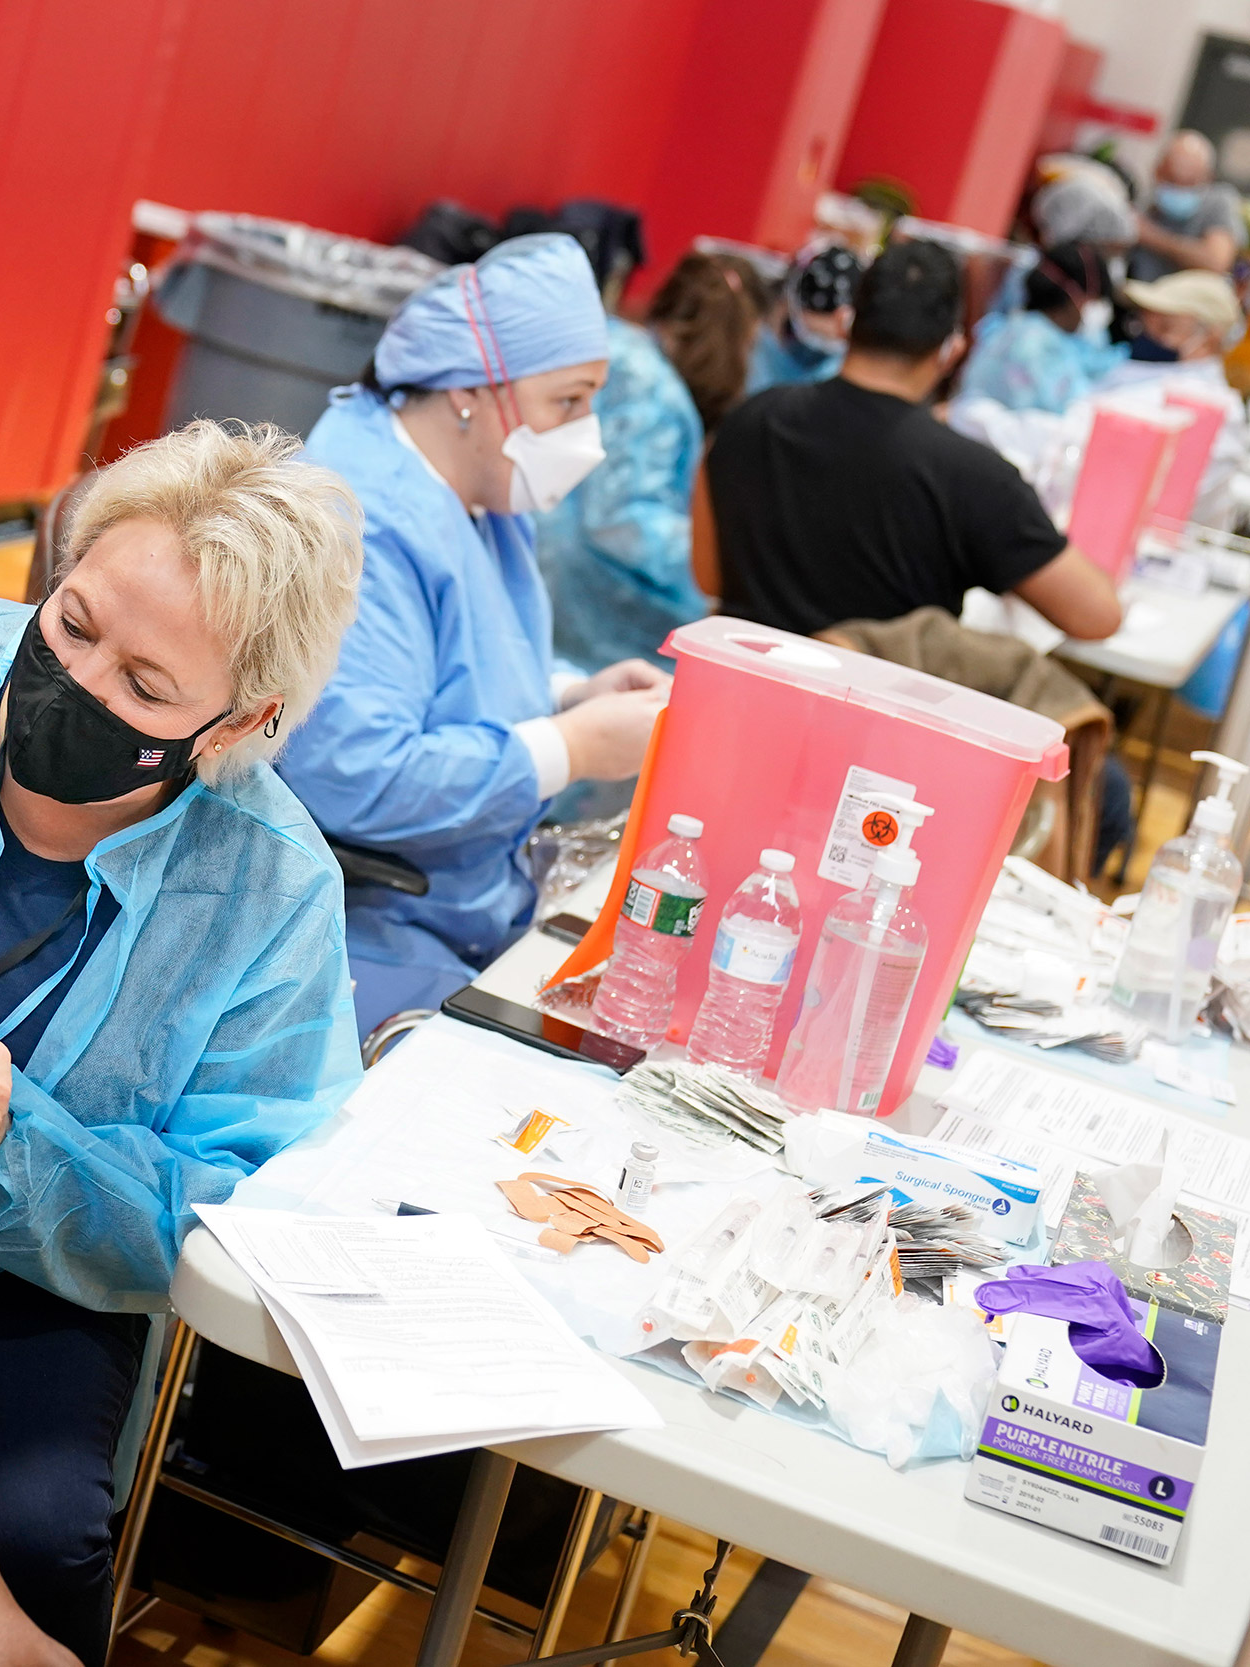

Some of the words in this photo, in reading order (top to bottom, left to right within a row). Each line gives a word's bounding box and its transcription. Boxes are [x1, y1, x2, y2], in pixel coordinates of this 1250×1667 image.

[895, 1170, 942, 1191] Surgical
[943, 1183, 992, 1205] Sponges
[1033, 1348, 1053, 1379] HALYARD
[1022, 1403, 1094, 1435] HALYARD
[992, 1436, 1067, 1469] POWDER-FREE
[1068, 1461, 1097, 1478] EXAM
[1099, 1469, 1141, 1493] GLOVES
[995, 1422, 1058, 1455] PURPLE
[1059, 1440, 1123, 1476] NITRILE
[1155, 1480, 1167, 1497] L
[1133, 1515, 1164, 1532] 55083
